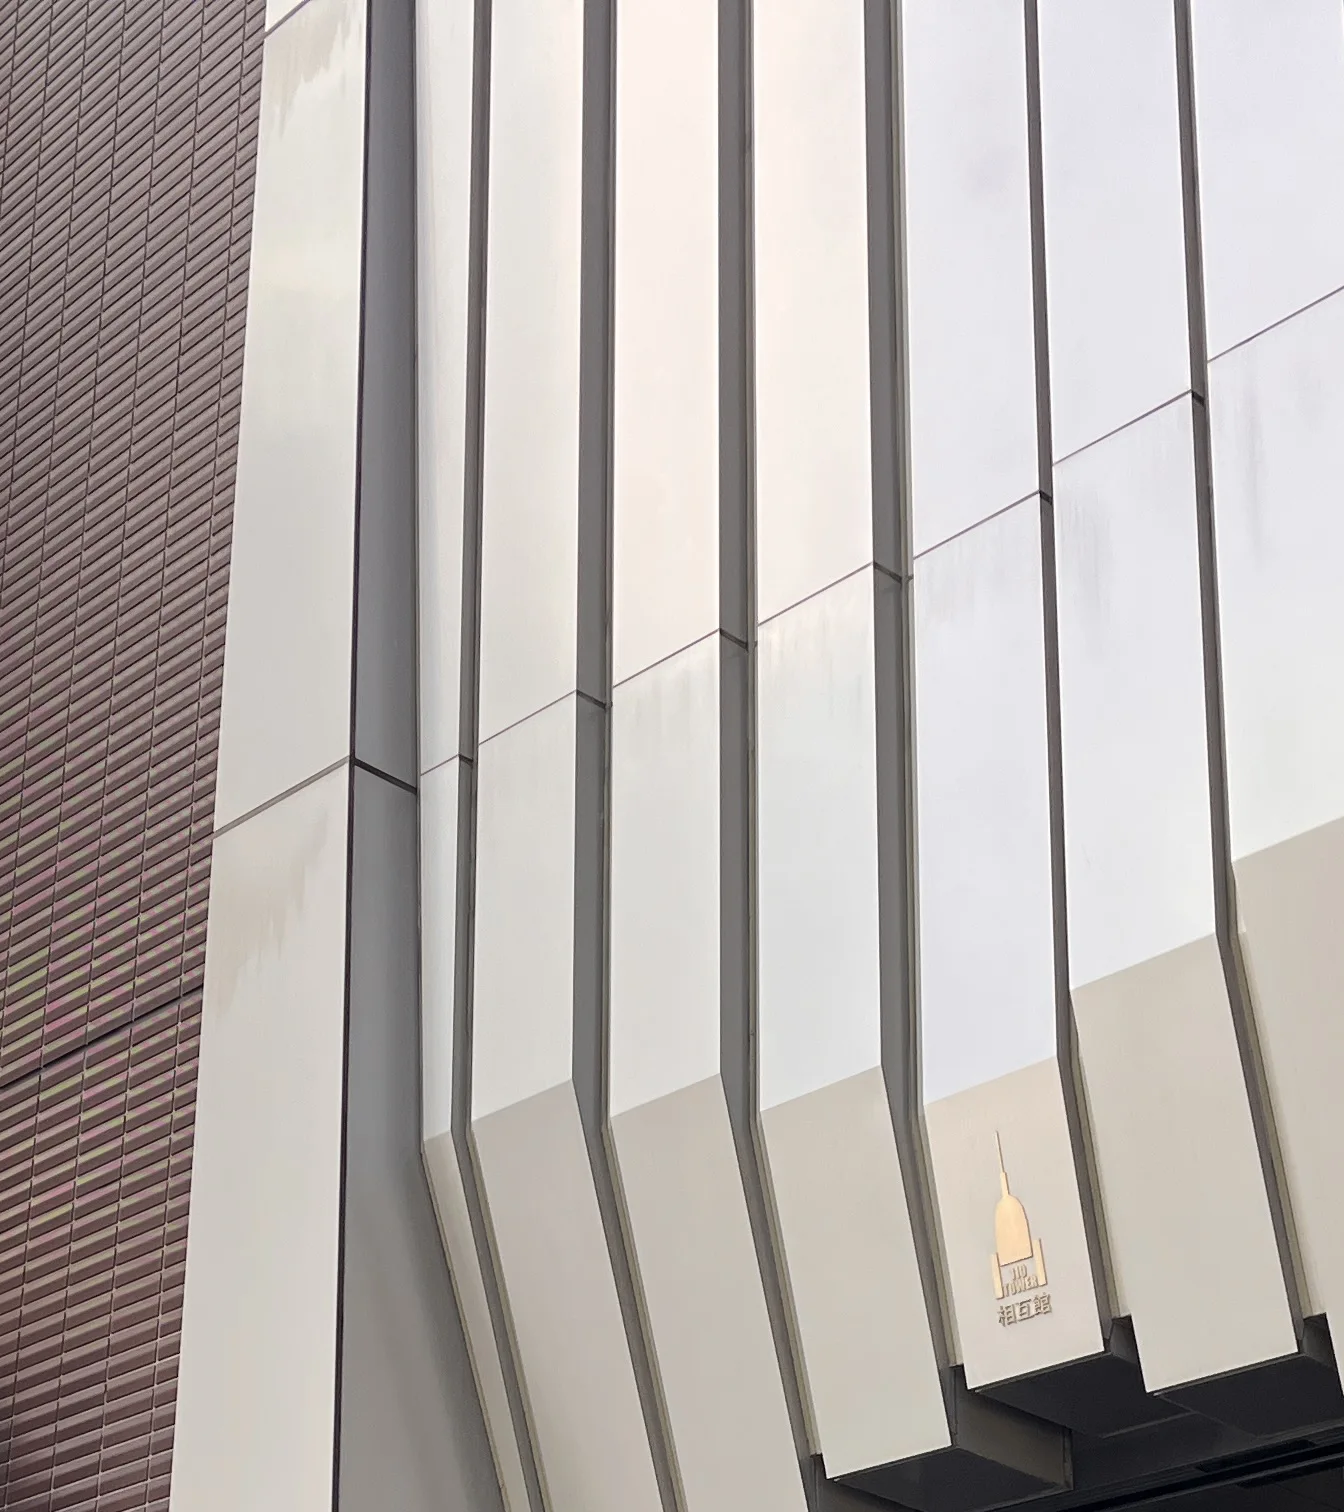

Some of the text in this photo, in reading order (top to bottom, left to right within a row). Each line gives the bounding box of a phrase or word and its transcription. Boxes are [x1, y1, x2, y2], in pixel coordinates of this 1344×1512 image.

[1005, 1275, 1039, 1296] TOWER
[998, 1293, 1051, 1327] 相互館
